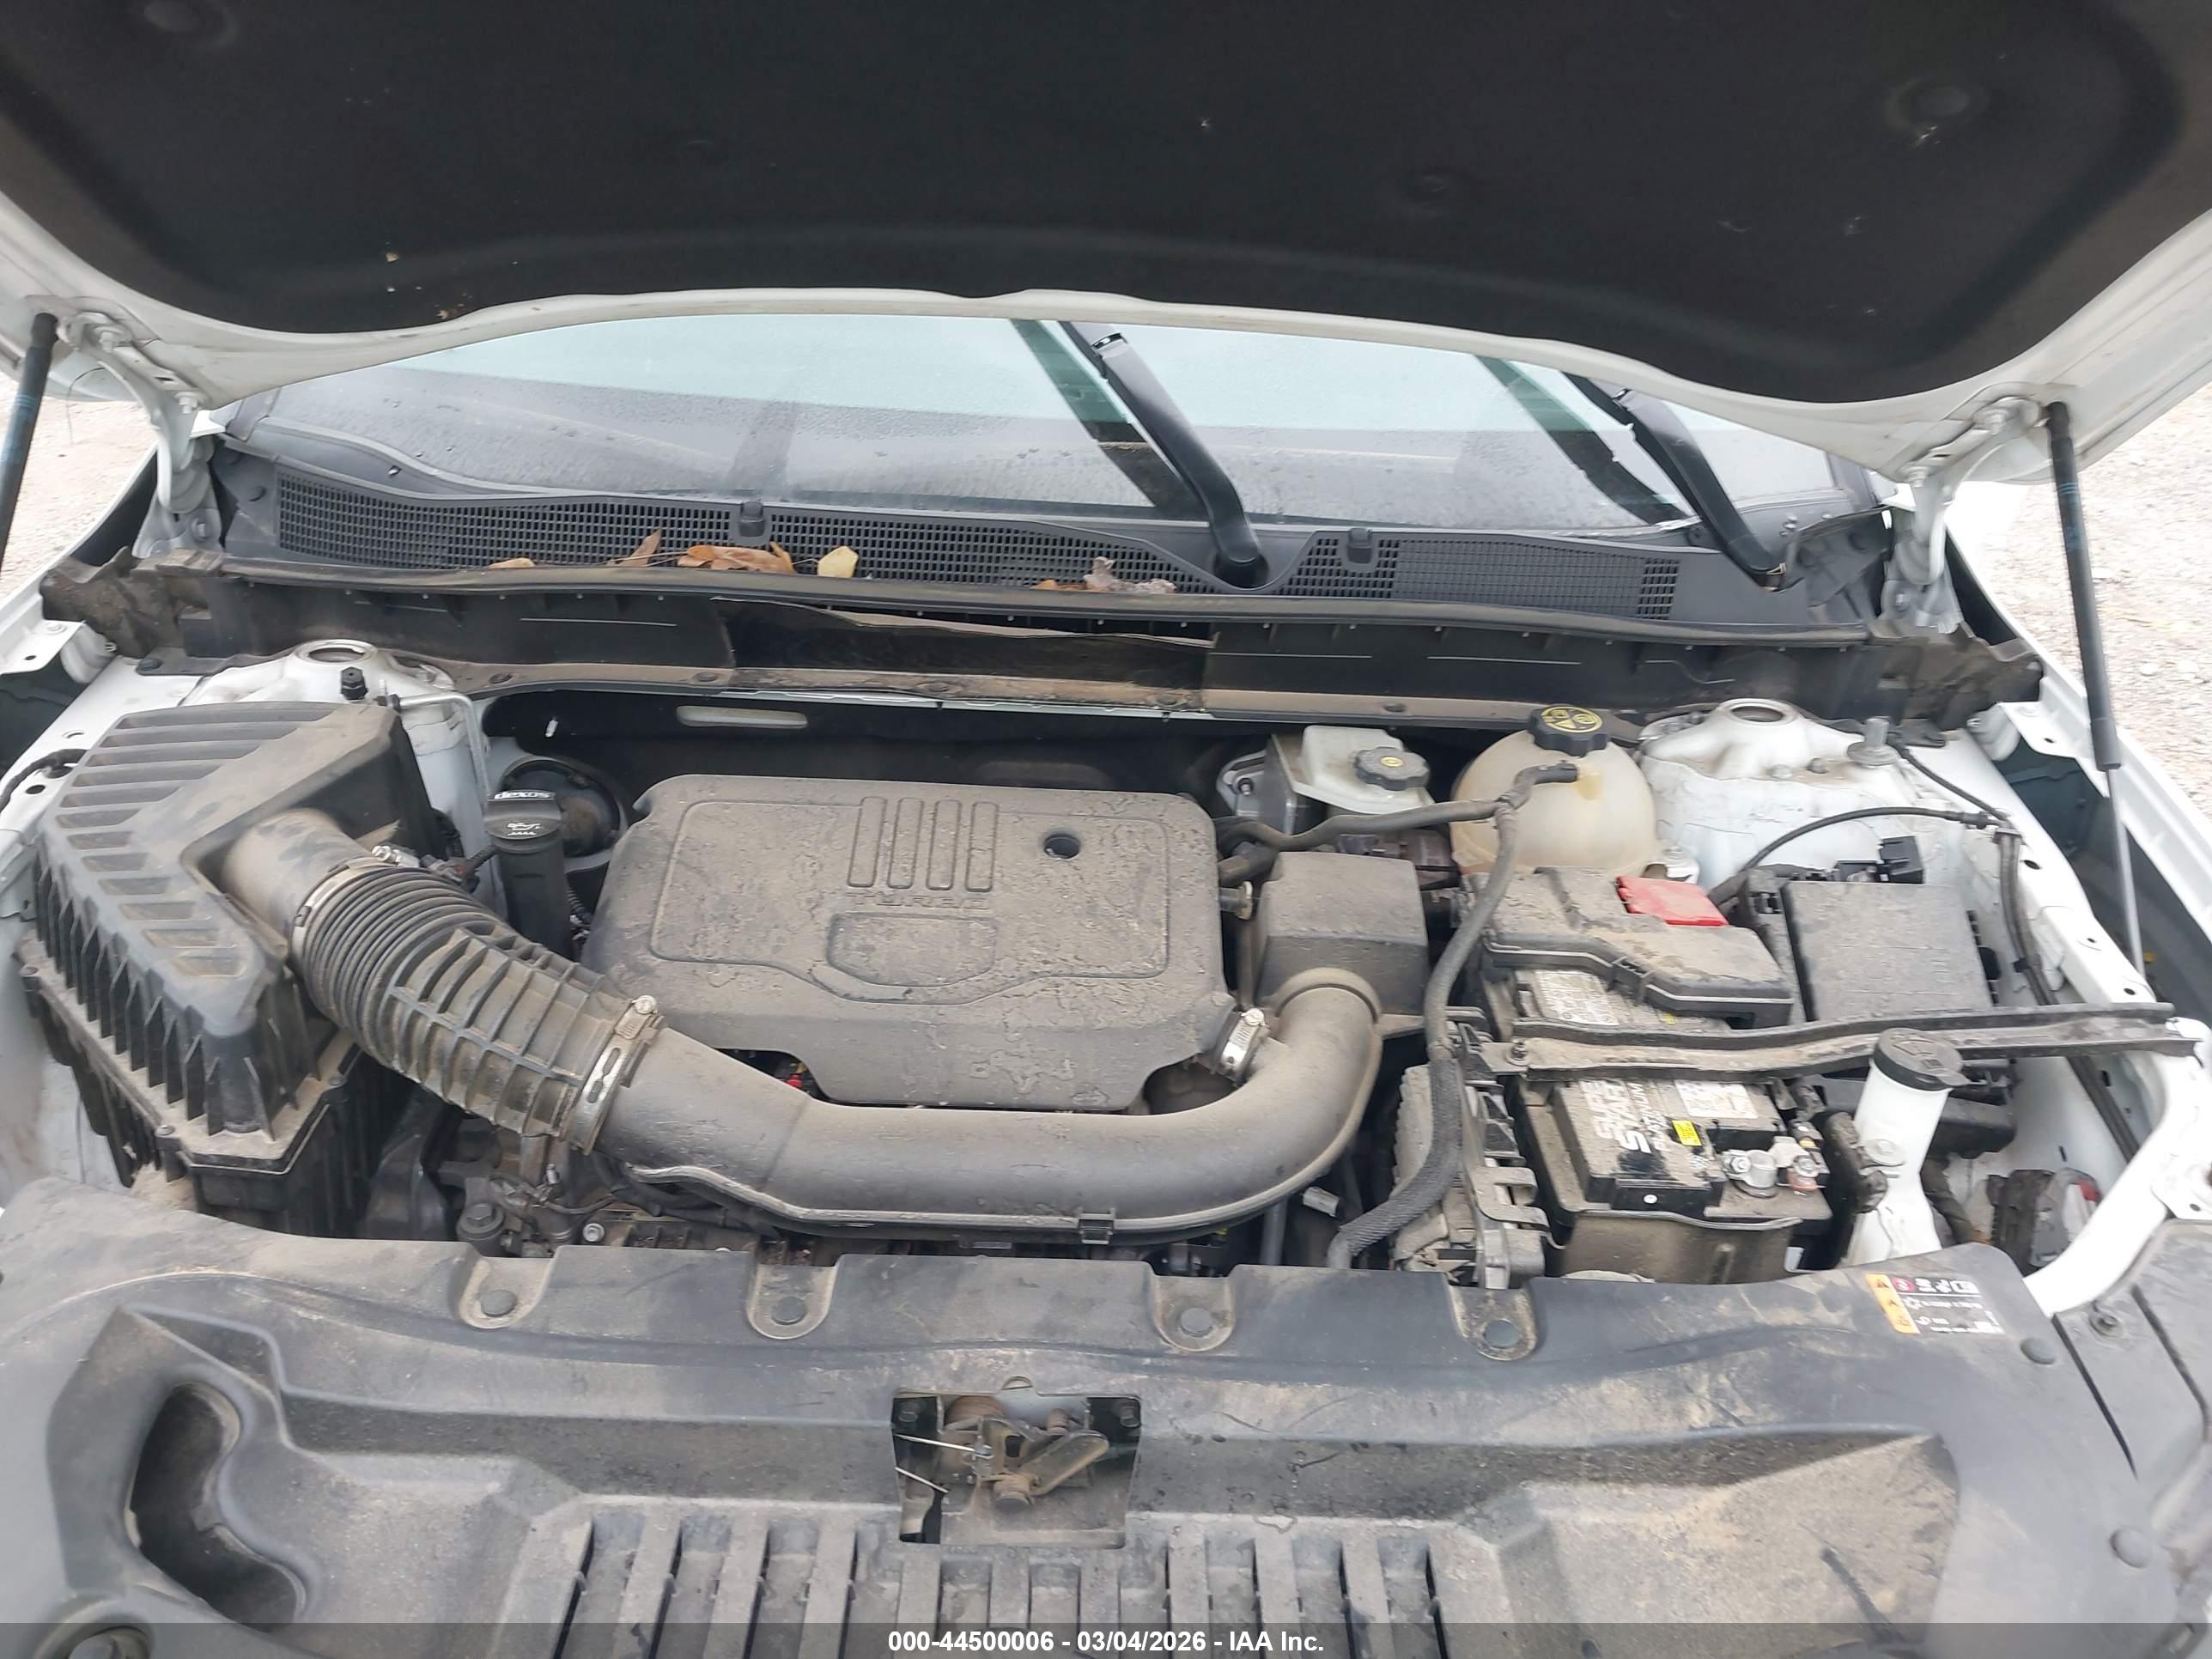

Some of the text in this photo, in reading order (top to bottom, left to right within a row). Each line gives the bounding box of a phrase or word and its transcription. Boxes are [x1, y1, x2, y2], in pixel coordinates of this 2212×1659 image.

[494, 791, 550, 799] dexos
[1578, 1080, 1614, 1139] SUPE
[1603, 1083, 1652, 1154] STAR
[1626, 1082, 1671, 1152] PLATINUM
